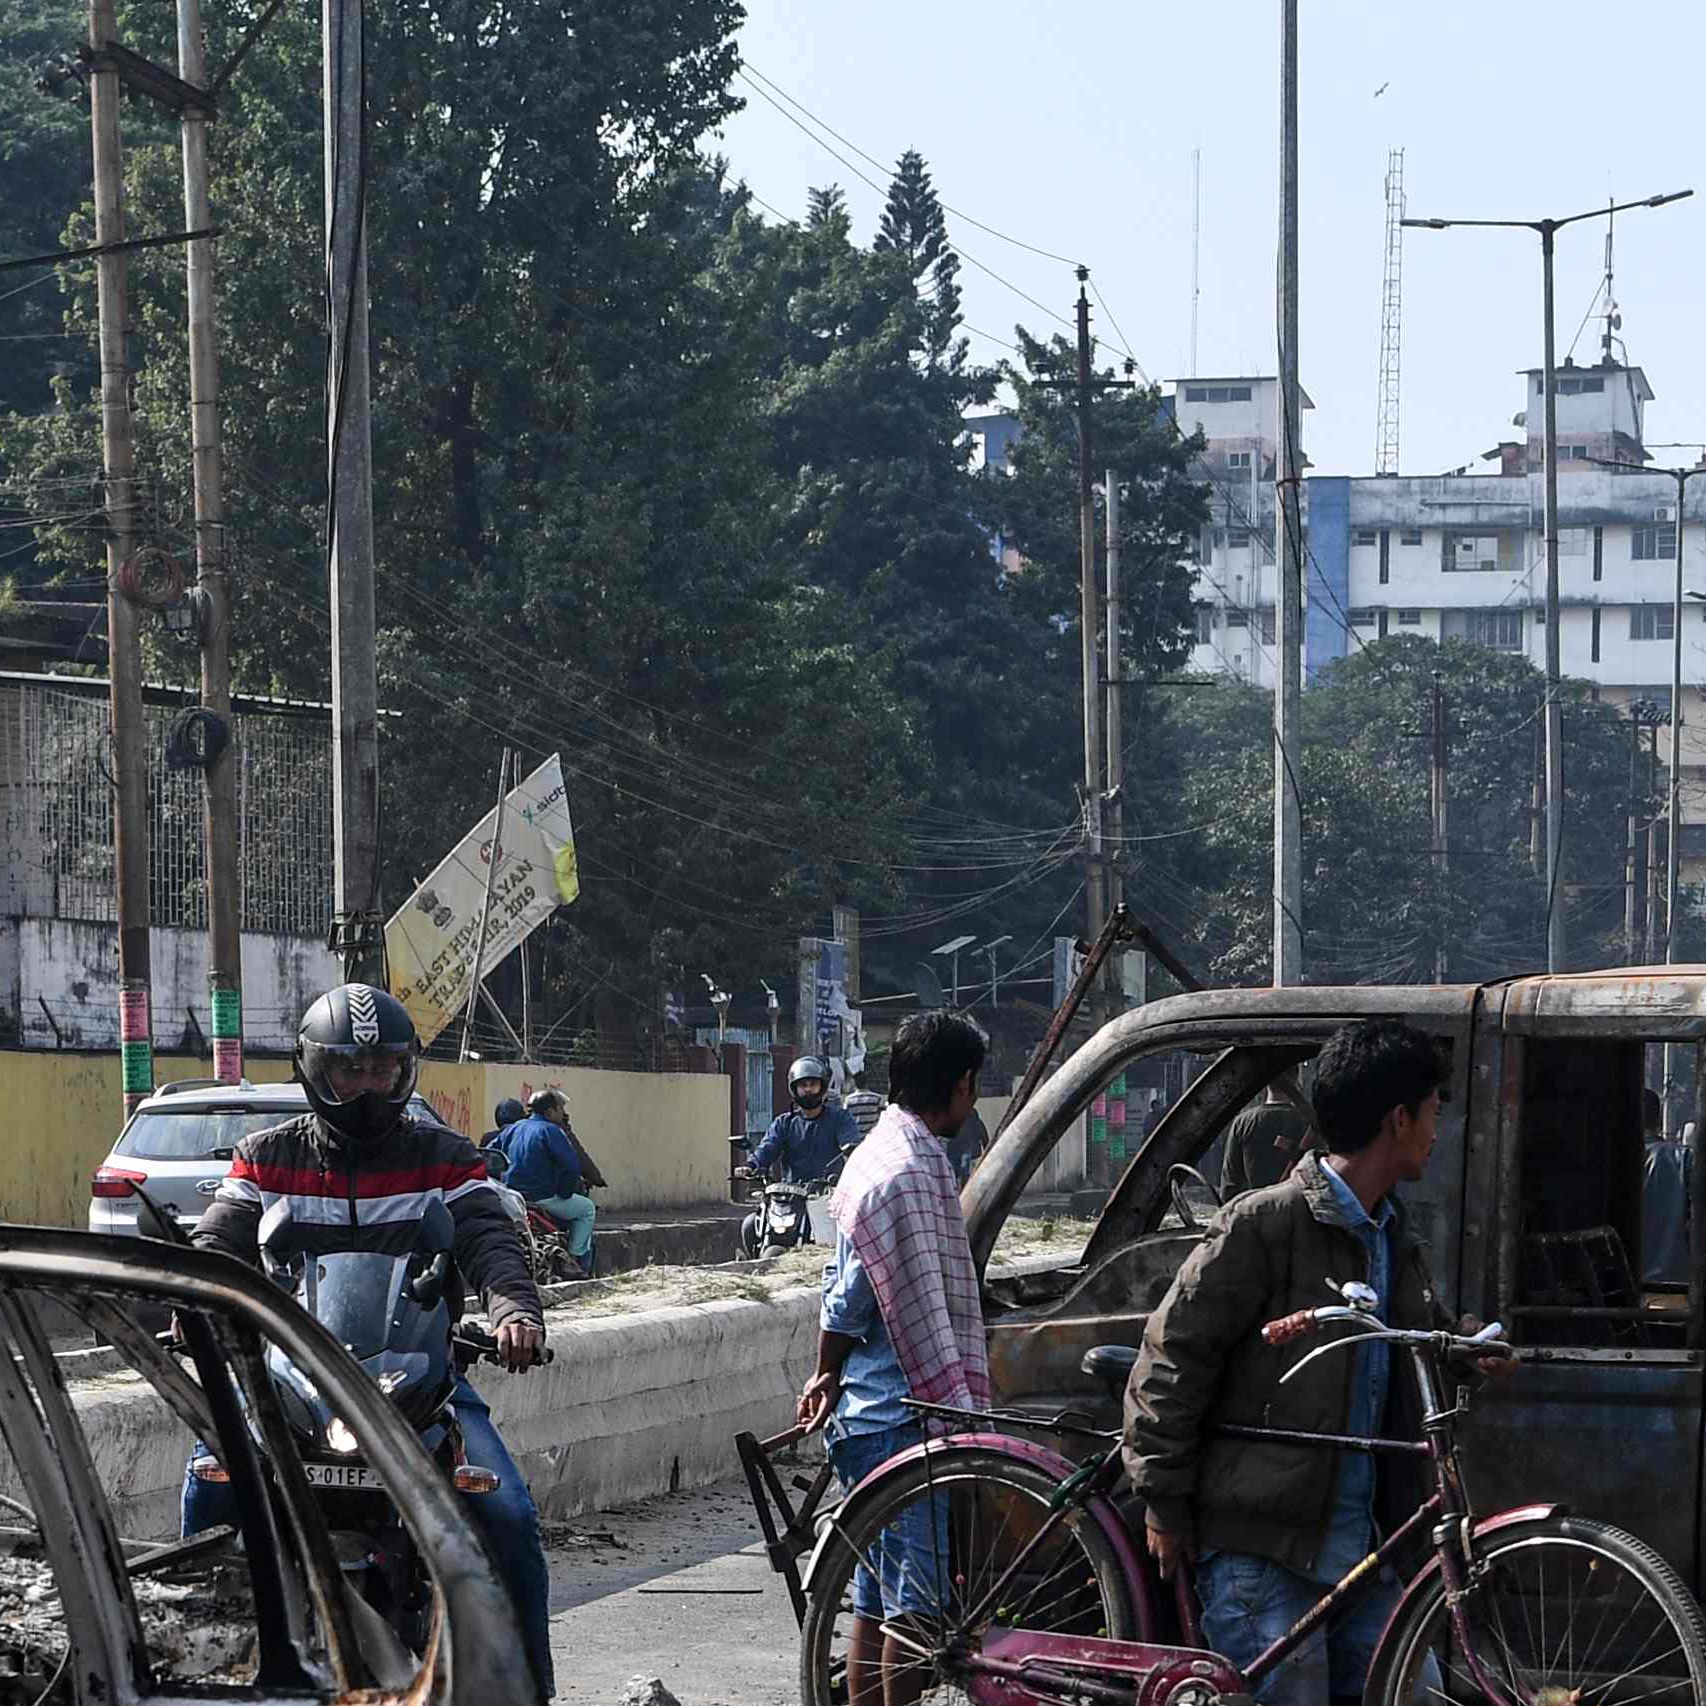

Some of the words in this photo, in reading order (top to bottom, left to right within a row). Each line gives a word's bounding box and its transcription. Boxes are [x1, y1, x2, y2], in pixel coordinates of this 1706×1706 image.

[504, 885, 536, 920] 2019
[416, 951, 451, 995] EAST
[449, 858, 534, 956] HIMAAYAN
[324, 1467, 367, 1486] 01EF
